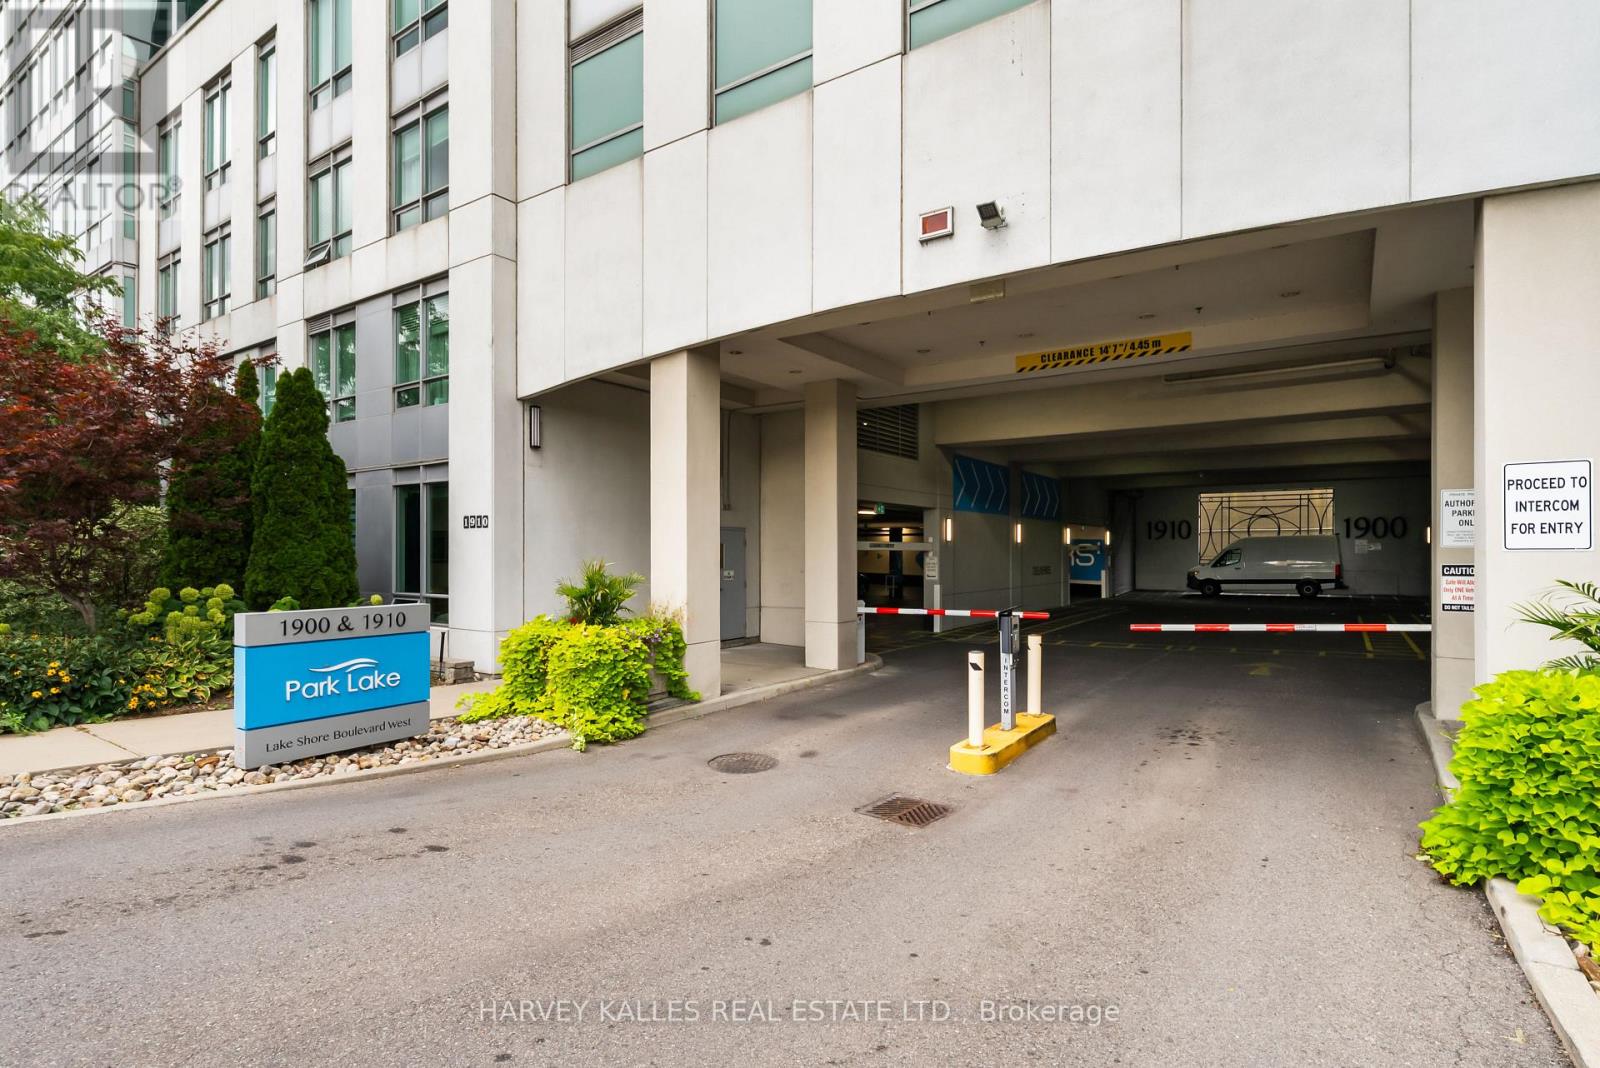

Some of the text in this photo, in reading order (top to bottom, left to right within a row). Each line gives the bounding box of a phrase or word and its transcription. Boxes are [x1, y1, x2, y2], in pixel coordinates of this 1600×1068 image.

[1040, 347, 1095, 364] CLEARANCE
[1129, 339, 1150, 351] 4.45
[1152, 338, 1161, 348] m
[1507, 476, 1588, 491] PROCEED TO
[1515, 499, 1580, 513] INTERCOM
[463, 515, 489, 529] 1910
[1147, 519, 1192, 540] 1910
[1343, 516, 1408, 540] 1900
[1511, 521, 1584, 535] FOR ENTRY
[280, 611, 407, 637] 1900 & 1910
[285, 670, 401, 701] Park Lake
[266, 717, 412, 753] Lake Shore Boulevard West
